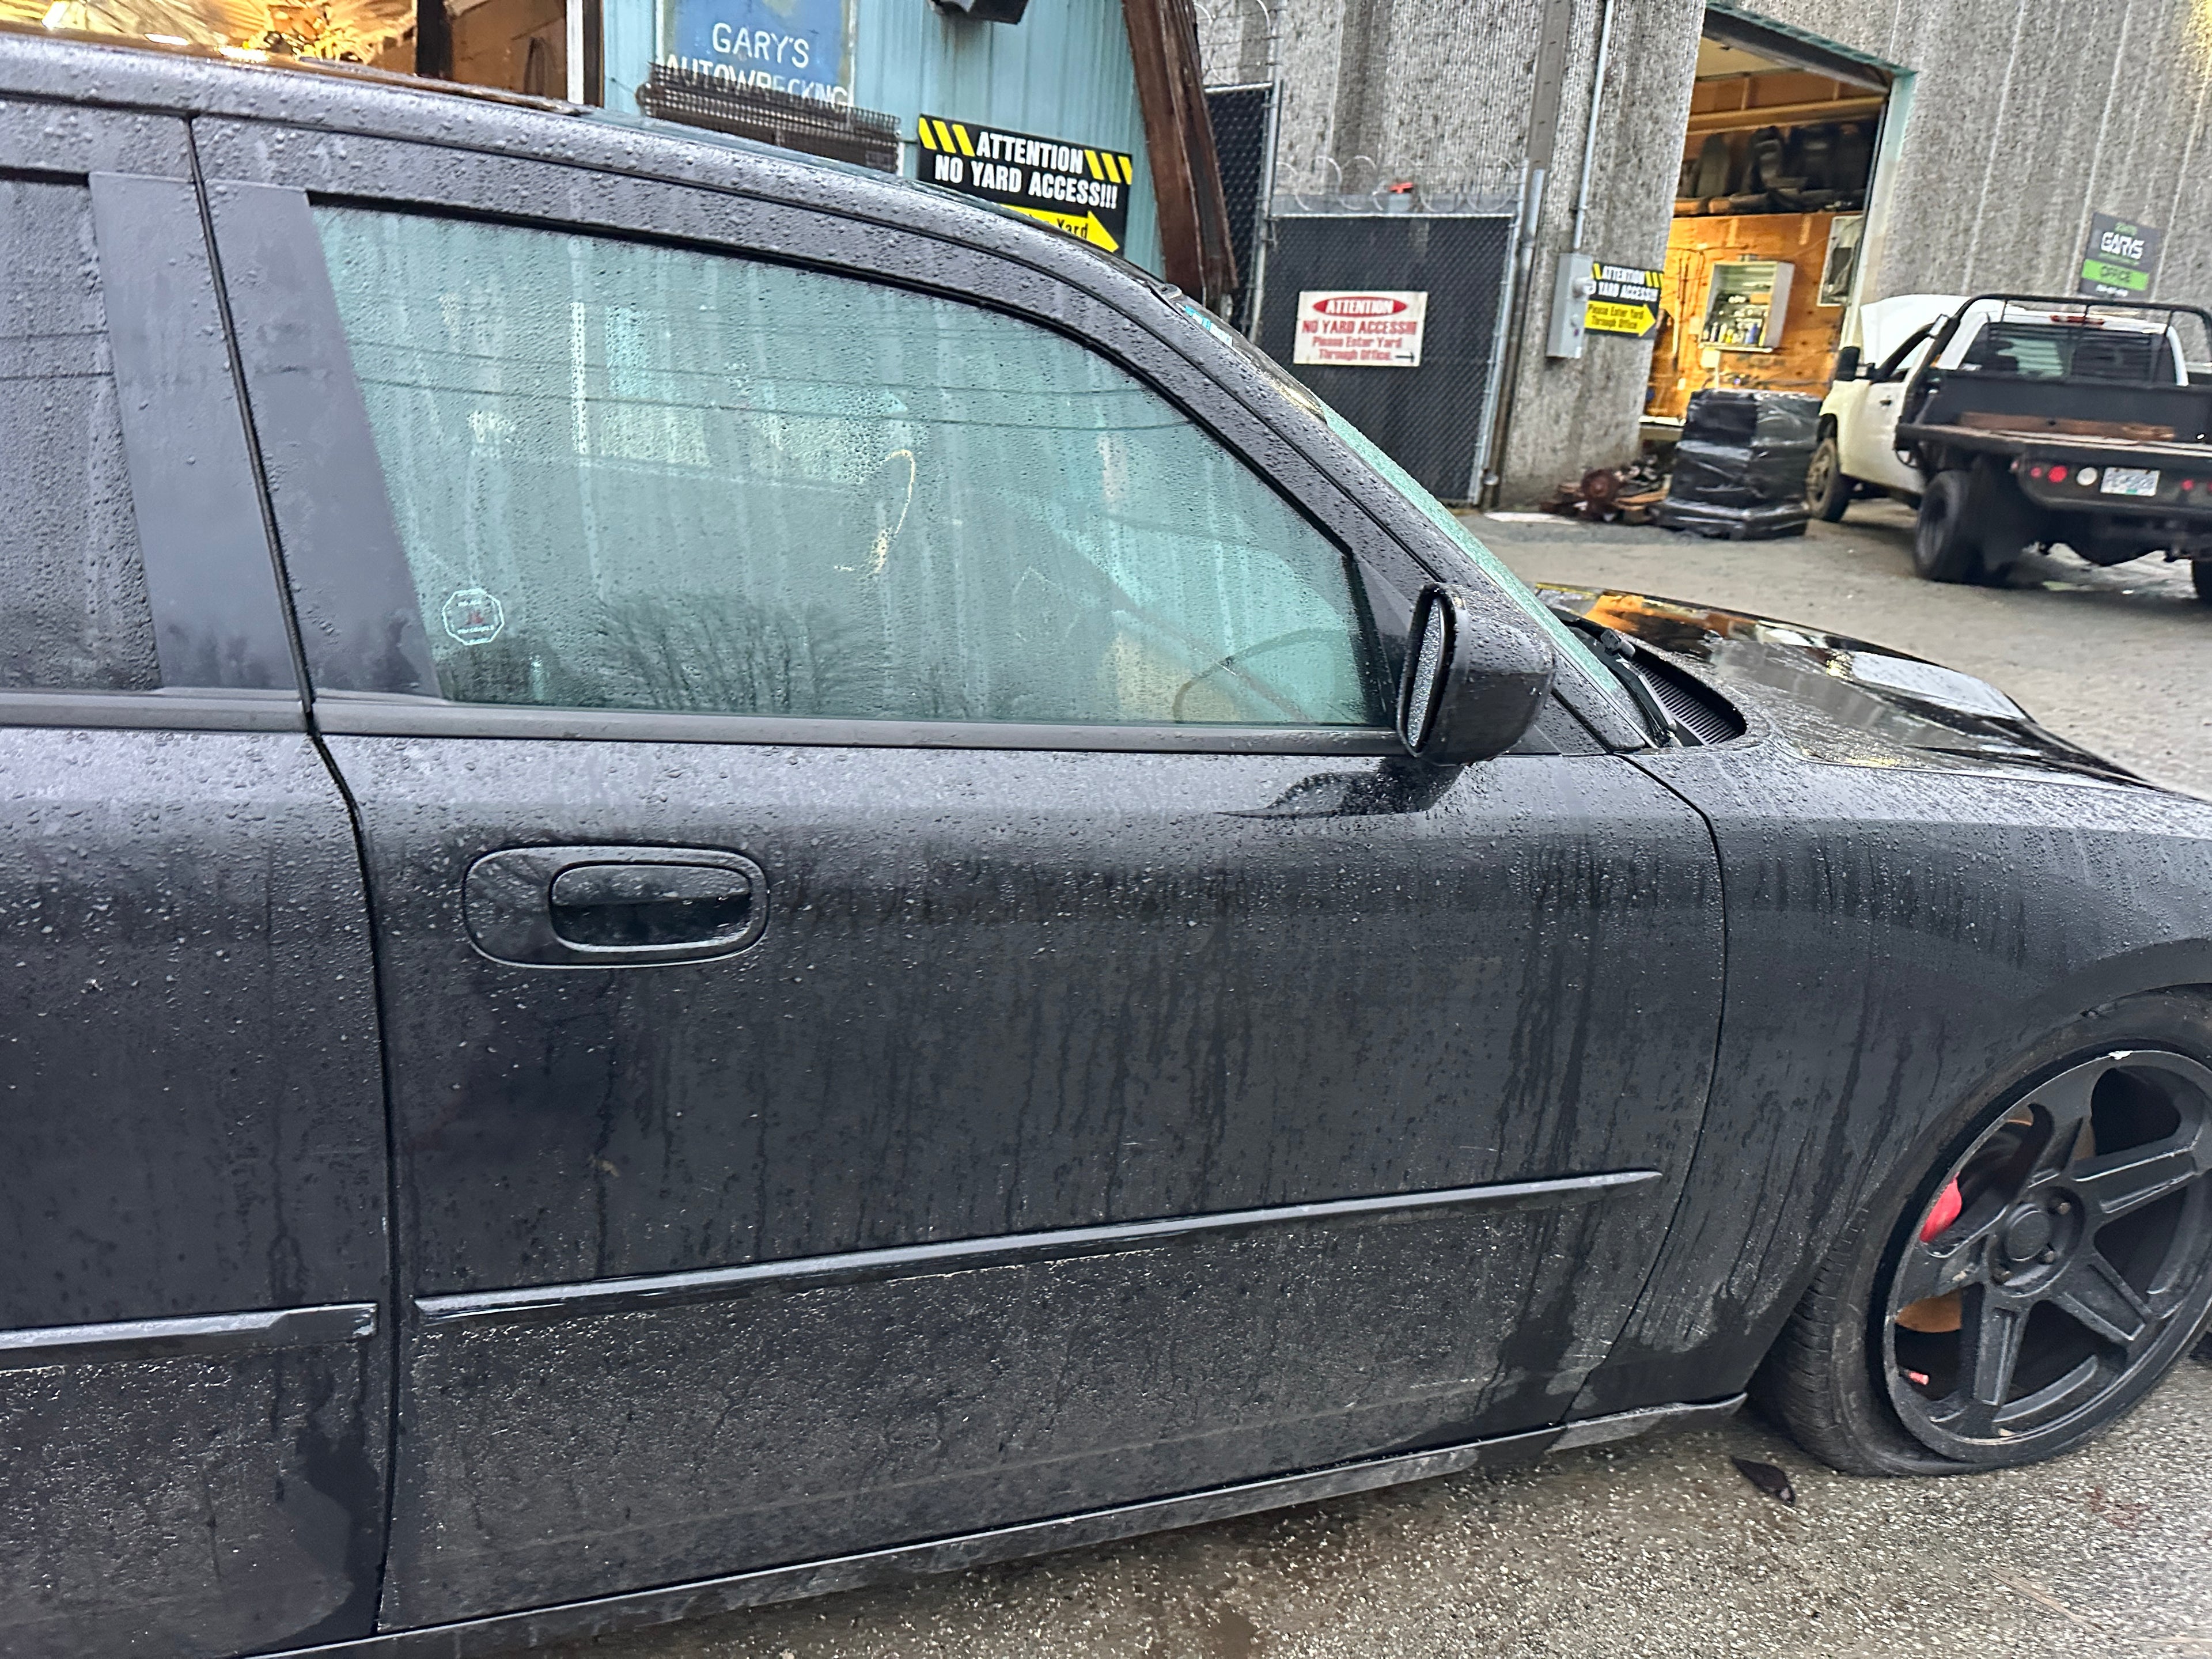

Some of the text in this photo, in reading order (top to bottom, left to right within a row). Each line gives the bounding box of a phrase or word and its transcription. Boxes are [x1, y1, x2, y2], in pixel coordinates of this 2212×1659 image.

[712, 22, 809, 69] GARY'S
[976, 131, 1083, 175] ATTENTION
[934, 154, 1118, 210] NO YARD ACCESS!!!
[1056, 218, 1088, 239] Yard
[1601, 266, 1646, 285] ATTENTION
[1598, 281, 1620, 298] YARD
[1324, 300, 1394, 315] ATTENTION
[1301, 320, 1319, 334] NO
[1322, 320, 1355, 334] YARD
[1346, 336, 1374, 347] Enter
[1377, 337, 1402, 349] Yard
